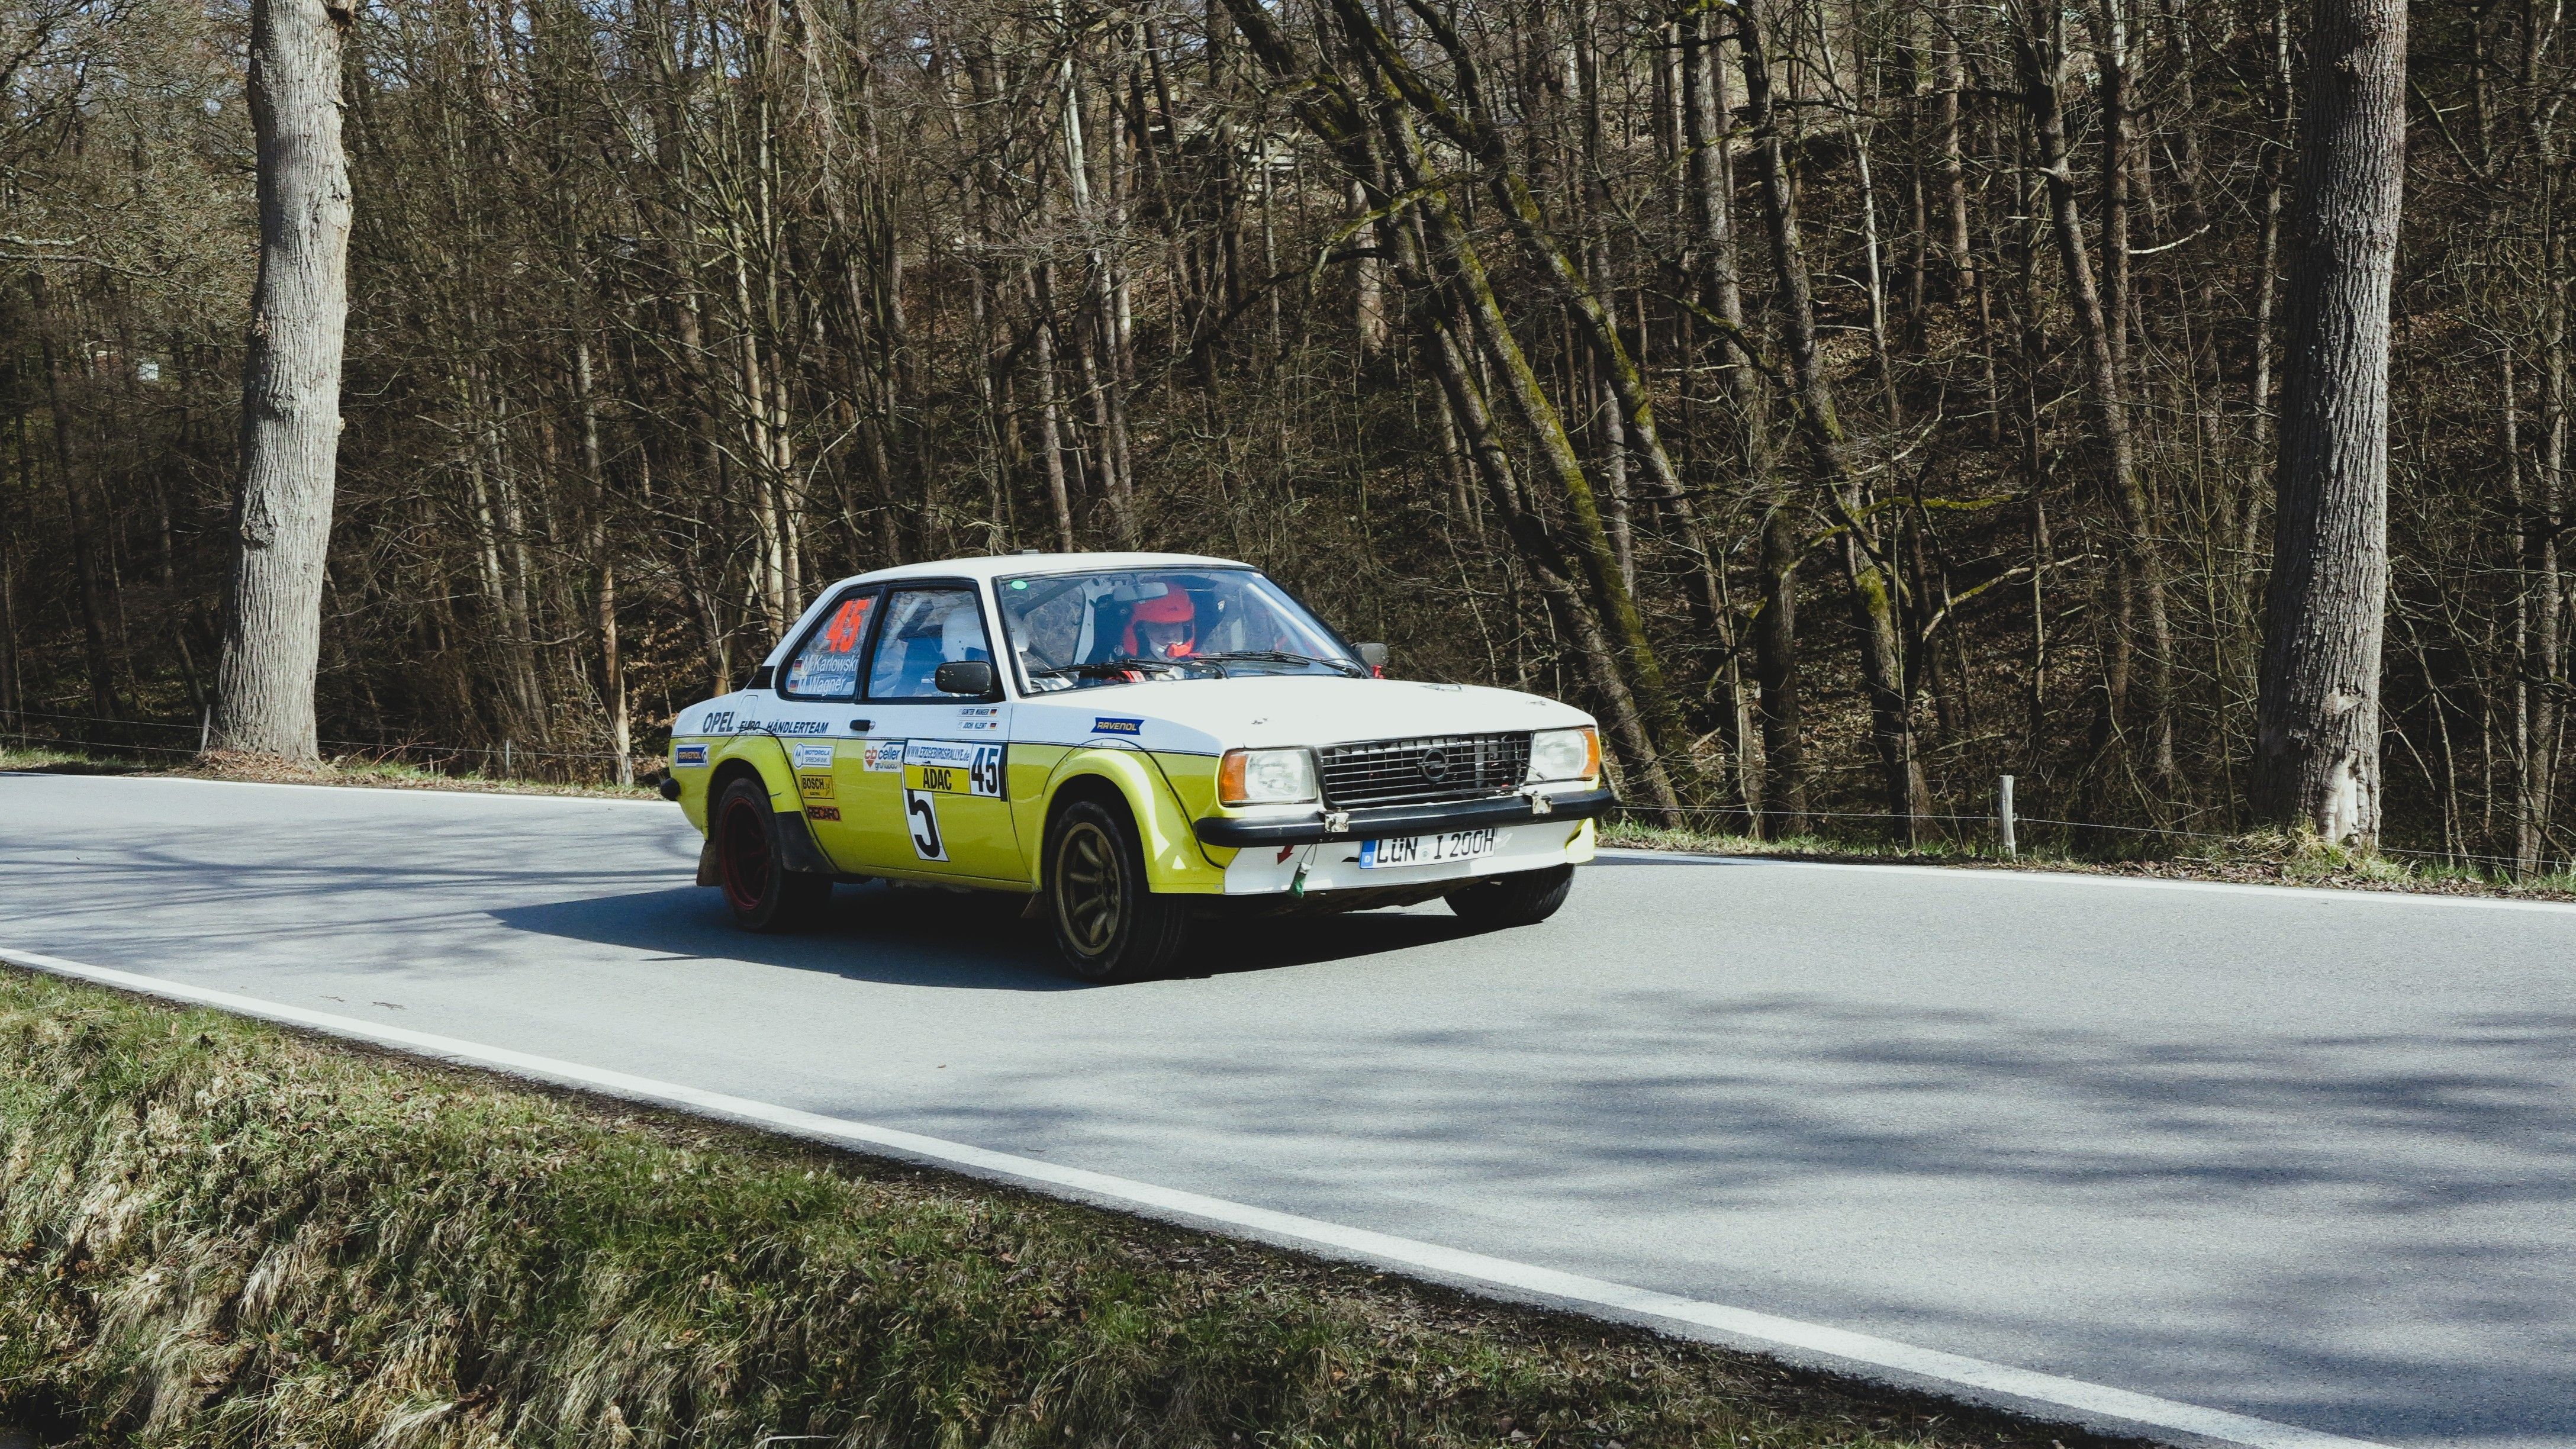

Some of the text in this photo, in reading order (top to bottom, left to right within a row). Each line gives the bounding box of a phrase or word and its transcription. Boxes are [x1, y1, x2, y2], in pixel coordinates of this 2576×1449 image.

[825, 600, 869, 653] 45
[703, 711, 829, 734] OPEL EURO HÄNDLERTEAM
[1097, 722, 1137, 731] RAVENOL
[878, 746, 901, 760] celler
[923, 768, 952, 791] ADAC
[971, 747, 1000, 794] 45
[802, 777, 825, 790] BOSCH
[807, 806, 841, 821] RECARO
[907, 790, 941, 858] 5
[1377, 837, 1418, 863] LÜN
[1450, 828, 1495, 858] 200H
